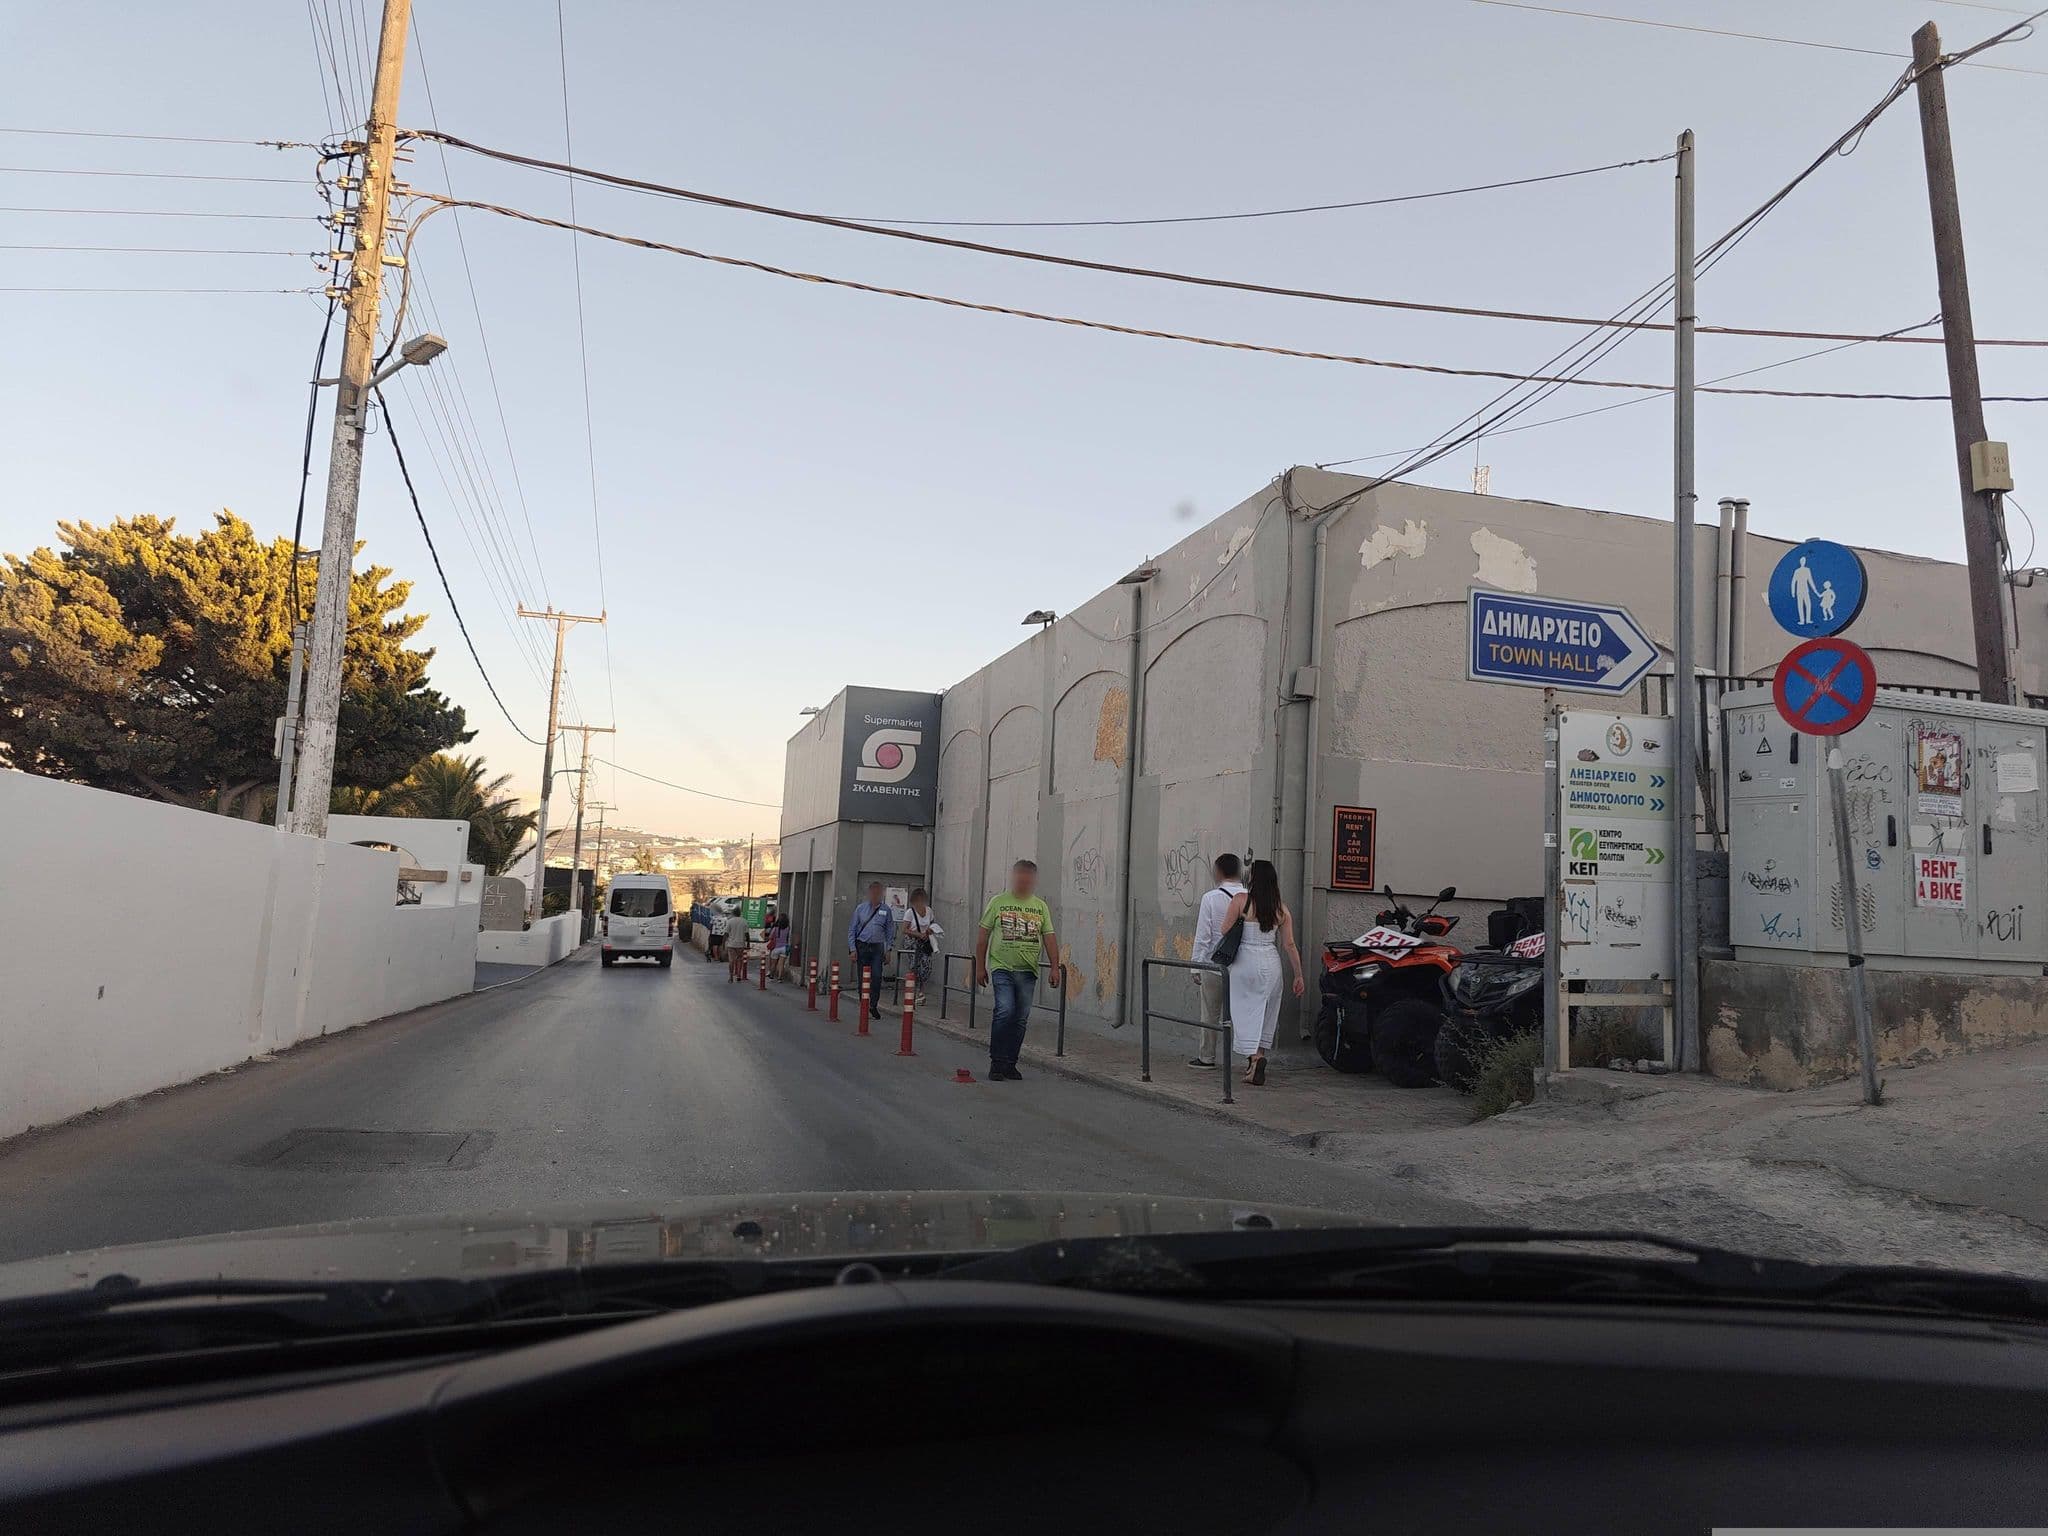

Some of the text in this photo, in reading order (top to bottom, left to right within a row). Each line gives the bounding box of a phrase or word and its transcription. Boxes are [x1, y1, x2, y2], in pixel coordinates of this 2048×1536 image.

[1482, 609, 1602, 648] ΔΗΜΑΡΧΕΙΟ
[1489, 643, 1595, 673] TOWN HALL
[864, 714, 922, 728] Supermarket
[1569, 768, 1637, 783] ΛΗΞΙΑΡΧΕΙΟ
[852, 784, 921, 797] ΣΚΛΑΒΕΝΙΤΗΣ
[1569, 790, 1646, 806] ΔΗΜΟΤΟΛΟΓΙΟ
[1345, 823, 1364, 831] RENT
[1599, 829, 1623, 839] ΚΕΝΤΡΟ
[1599, 841, 1644, 851] ΕΞΥΠΗΡΕΤΗΣΗΣ
[1338, 854, 1369, 863] SCOOTER
[1599, 852, 1625, 862] ΠΟΛΙΤΩΝ
[1569, 861, 1598, 876] ΚΕΠ
[1921, 859, 1957, 879] RENT
[1918, 880, 1963, 901] A BIKE
[1368, 931, 1414, 947] ATV
